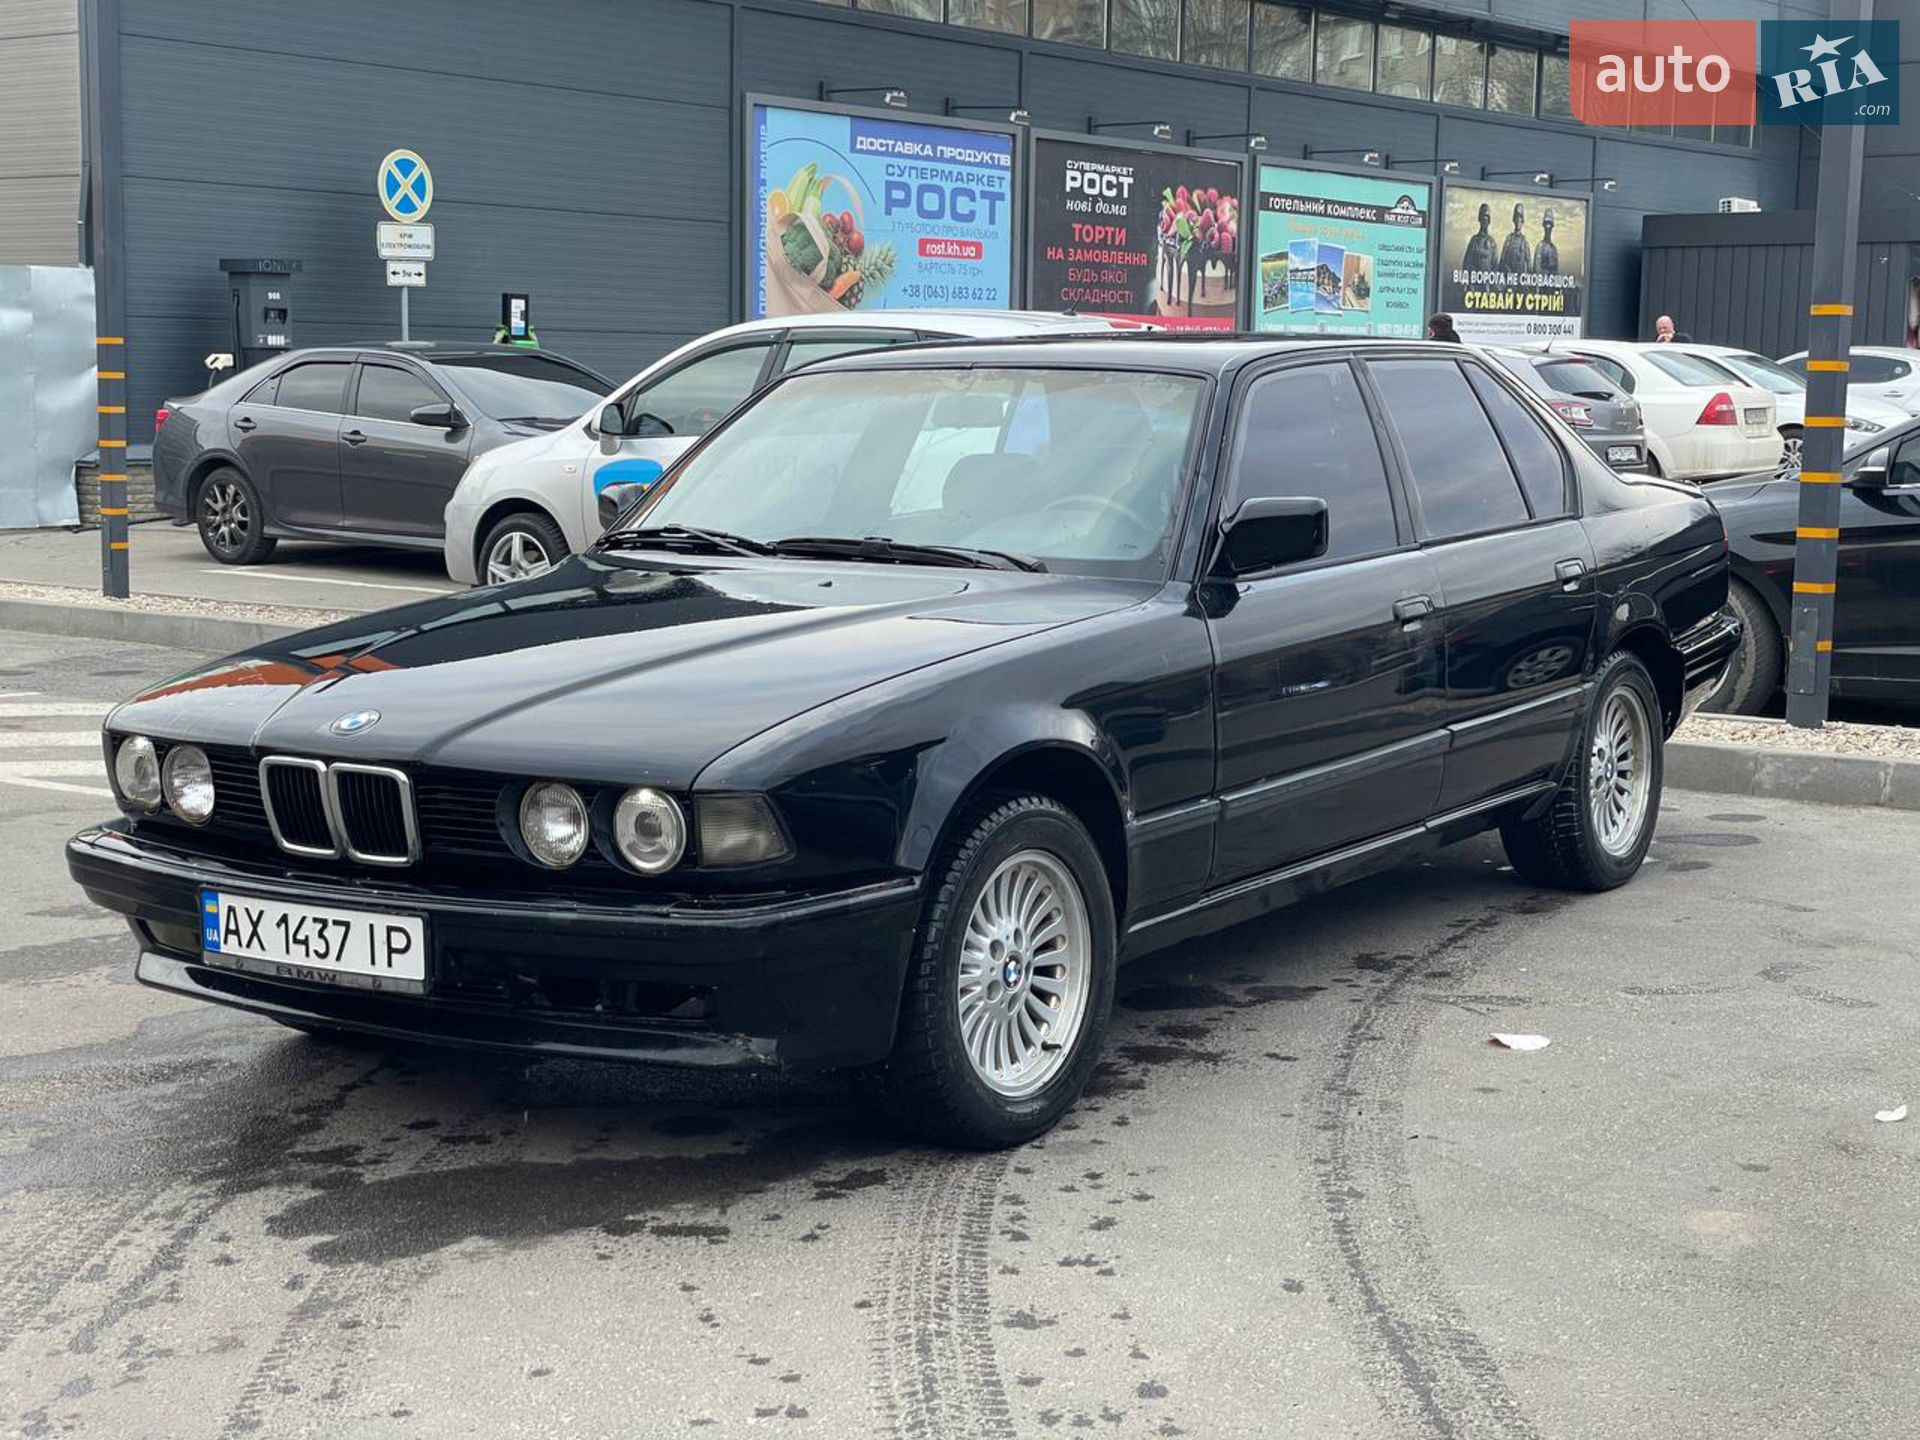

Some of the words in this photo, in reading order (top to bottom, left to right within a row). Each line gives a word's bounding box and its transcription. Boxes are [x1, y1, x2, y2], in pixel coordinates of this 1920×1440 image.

[856, 136, 933, 157] ДОСТАВКА
[936, 146, 1011, 166] ПРОДУКТІВ
[885, 163, 1005, 188] СУПЕРМАРКЕТ
[1066, 160, 1134, 176] СУПЕРМАРКЕТ
[1065, 169, 1134, 199] РОСТ
[884, 180, 1006, 225] РОСТ
[1066, 198, 1092, 213] нові
[1095, 197, 1127, 216] дома
[1326, 204, 1377, 220] комплекс
[1072, 223, 1127, 246] ТОРТИ
[926, 242, 976, 257] rost.kh.ua
[1047, 247, 1064, 261] НА
[1067, 248, 1148, 266] ЗАМОВЛЕННЯ
[1068, 268, 1098, 283] БУДЬ
[1100, 269, 1128, 284] ЯКОЇ
[1453, 269, 1469, 285] ВІД
[1470, 271, 1505, 286] ВОРОГА
[1507, 272, 1518, 286] НЕ
[902, 284, 920, 298] +38
[923, 284, 949, 301] (063)
[951, 286, 969, 299] 683
[971, 287, 983, 300] 62
[985, 287, 997, 300] 22
[1061, 287, 1133, 304] СКЛАДНОСТІ
[1464, 288, 1513, 309] СТАВАЙ
[1515, 292, 1523, 309] У
[1525, 290, 1564, 311] СТРІЙ!
[1526, 323, 1532, 335] 0
[1533, 323, 1547, 335] 800
[1548, 323, 1561, 335] 300
[1562, 323, 1574, 335] 441
[206, 928, 219, 943] UA
[223, 904, 266, 951] AX
[275, 912, 351, 962] 1437
[368, 922, 412, 968] IP
[276, 965, 337, 983] BMW
